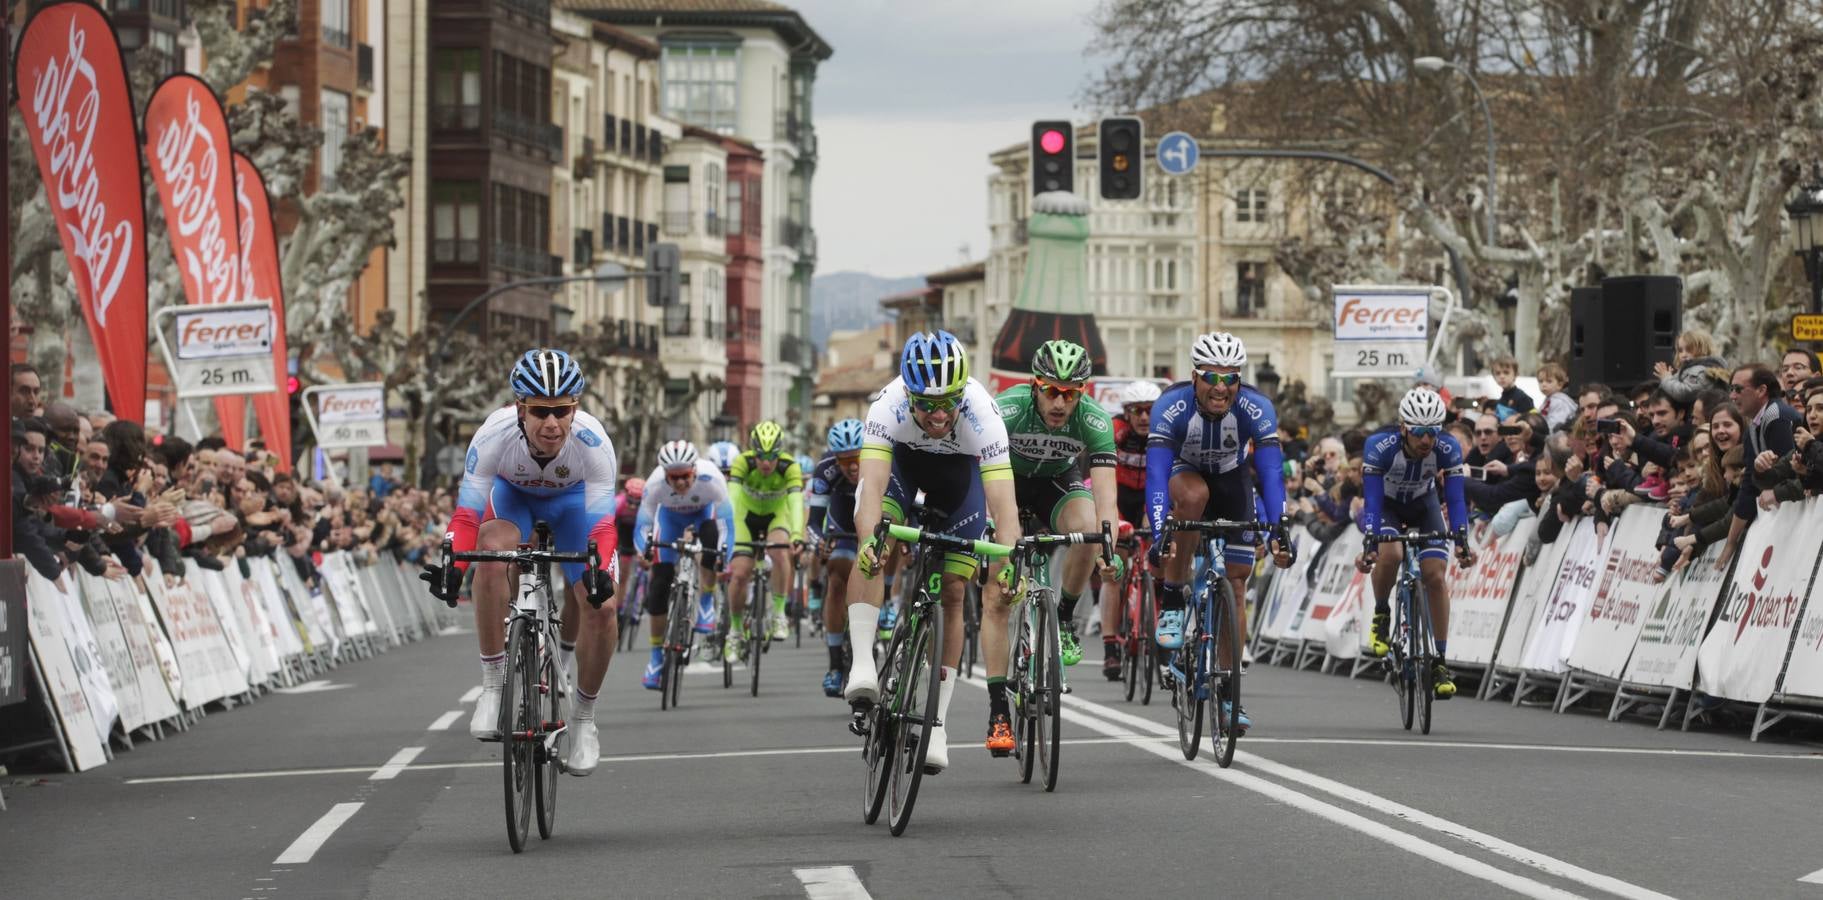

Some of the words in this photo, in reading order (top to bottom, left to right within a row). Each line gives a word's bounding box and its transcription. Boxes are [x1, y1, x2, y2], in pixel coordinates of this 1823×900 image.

[1338, 298, 1425, 327] Ferrer
[182, 317, 266, 347] Ferrer
[1357, 350, 1380, 366] 25
[1387, 352, 1409, 365] m.
[201, 369, 224, 384] 25
[232, 369, 254, 383] m.
[322, 396, 379, 414] Ferrer
[1162, 399, 1187, 424] MEO
[1239, 396, 1263, 421] MEO
[868, 421, 888, 434] BIKE
[980, 440, 1000, 455] BIKE
[1375, 434, 1397, 455] MEO
[1152, 492, 1164, 504] FC
[1153, 504, 1164, 530] Porto
[1661, 597, 1682, 645] La
